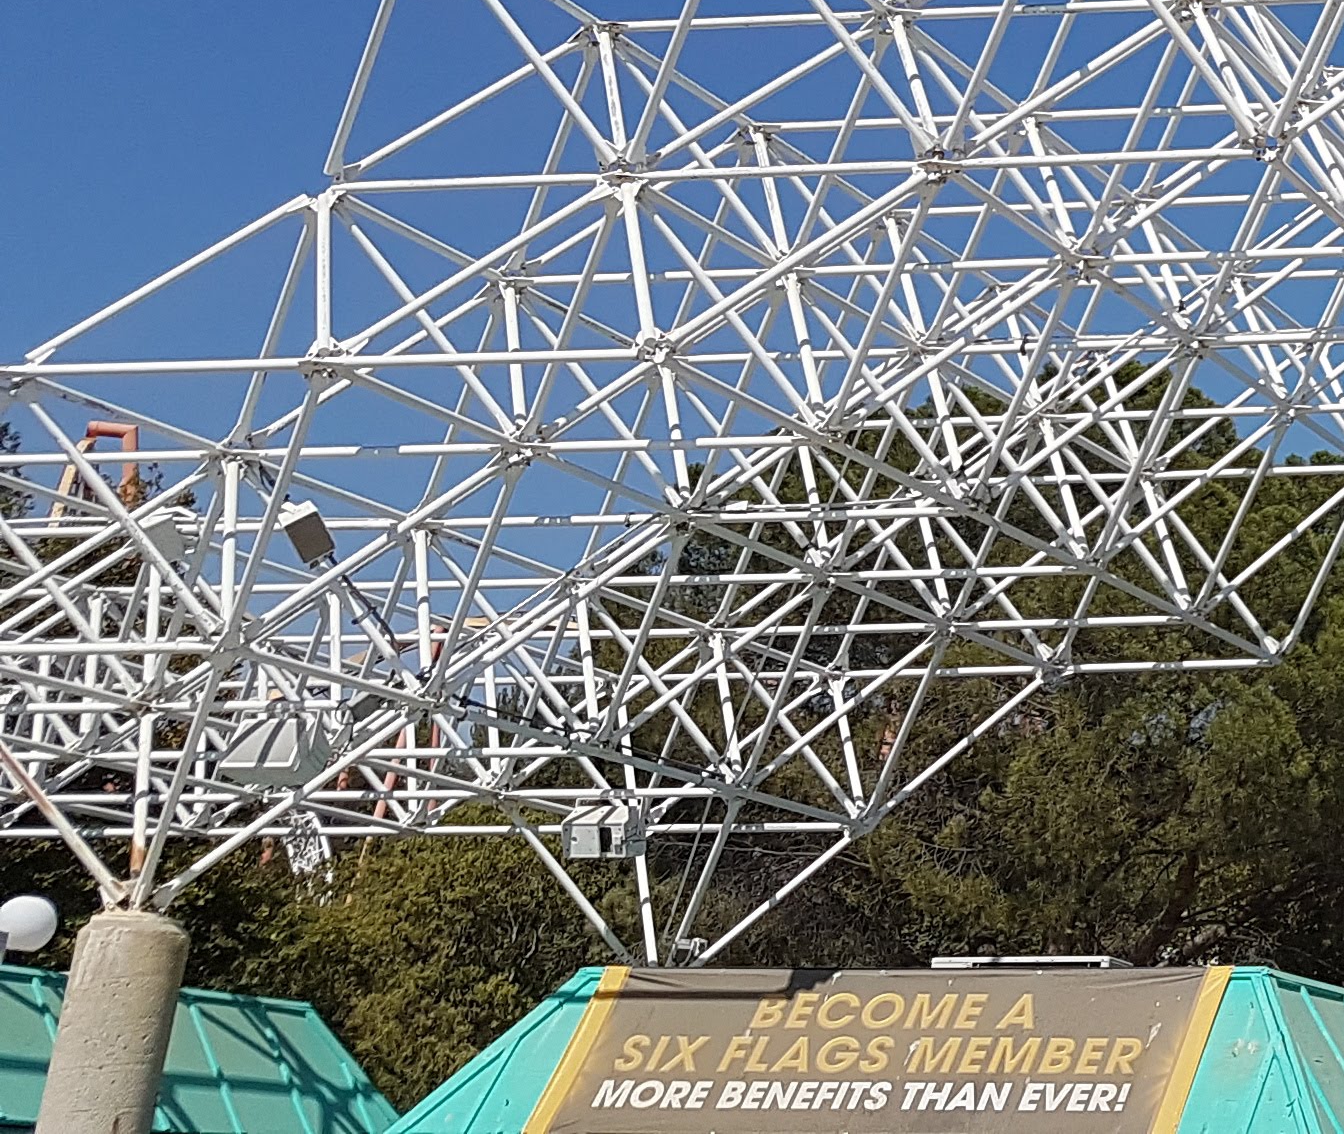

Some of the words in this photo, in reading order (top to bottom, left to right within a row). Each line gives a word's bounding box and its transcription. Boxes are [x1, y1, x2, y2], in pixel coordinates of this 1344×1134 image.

[752, 992, 986, 1031] BECOME
[995, 992, 1037, 1030] A
[613, 1033, 710, 1073] SIX
[715, 1033, 896, 1074] FLAGS
[902, 1035, 1144, 1075] MEMBER
[590, 1078, 711, 1110] MORE
[714, 1079, 893, 1111] BENEFITS
[900, 1080, 1012, 1112] THAN
[1018, 1081, 1129, 1113] EVER!
